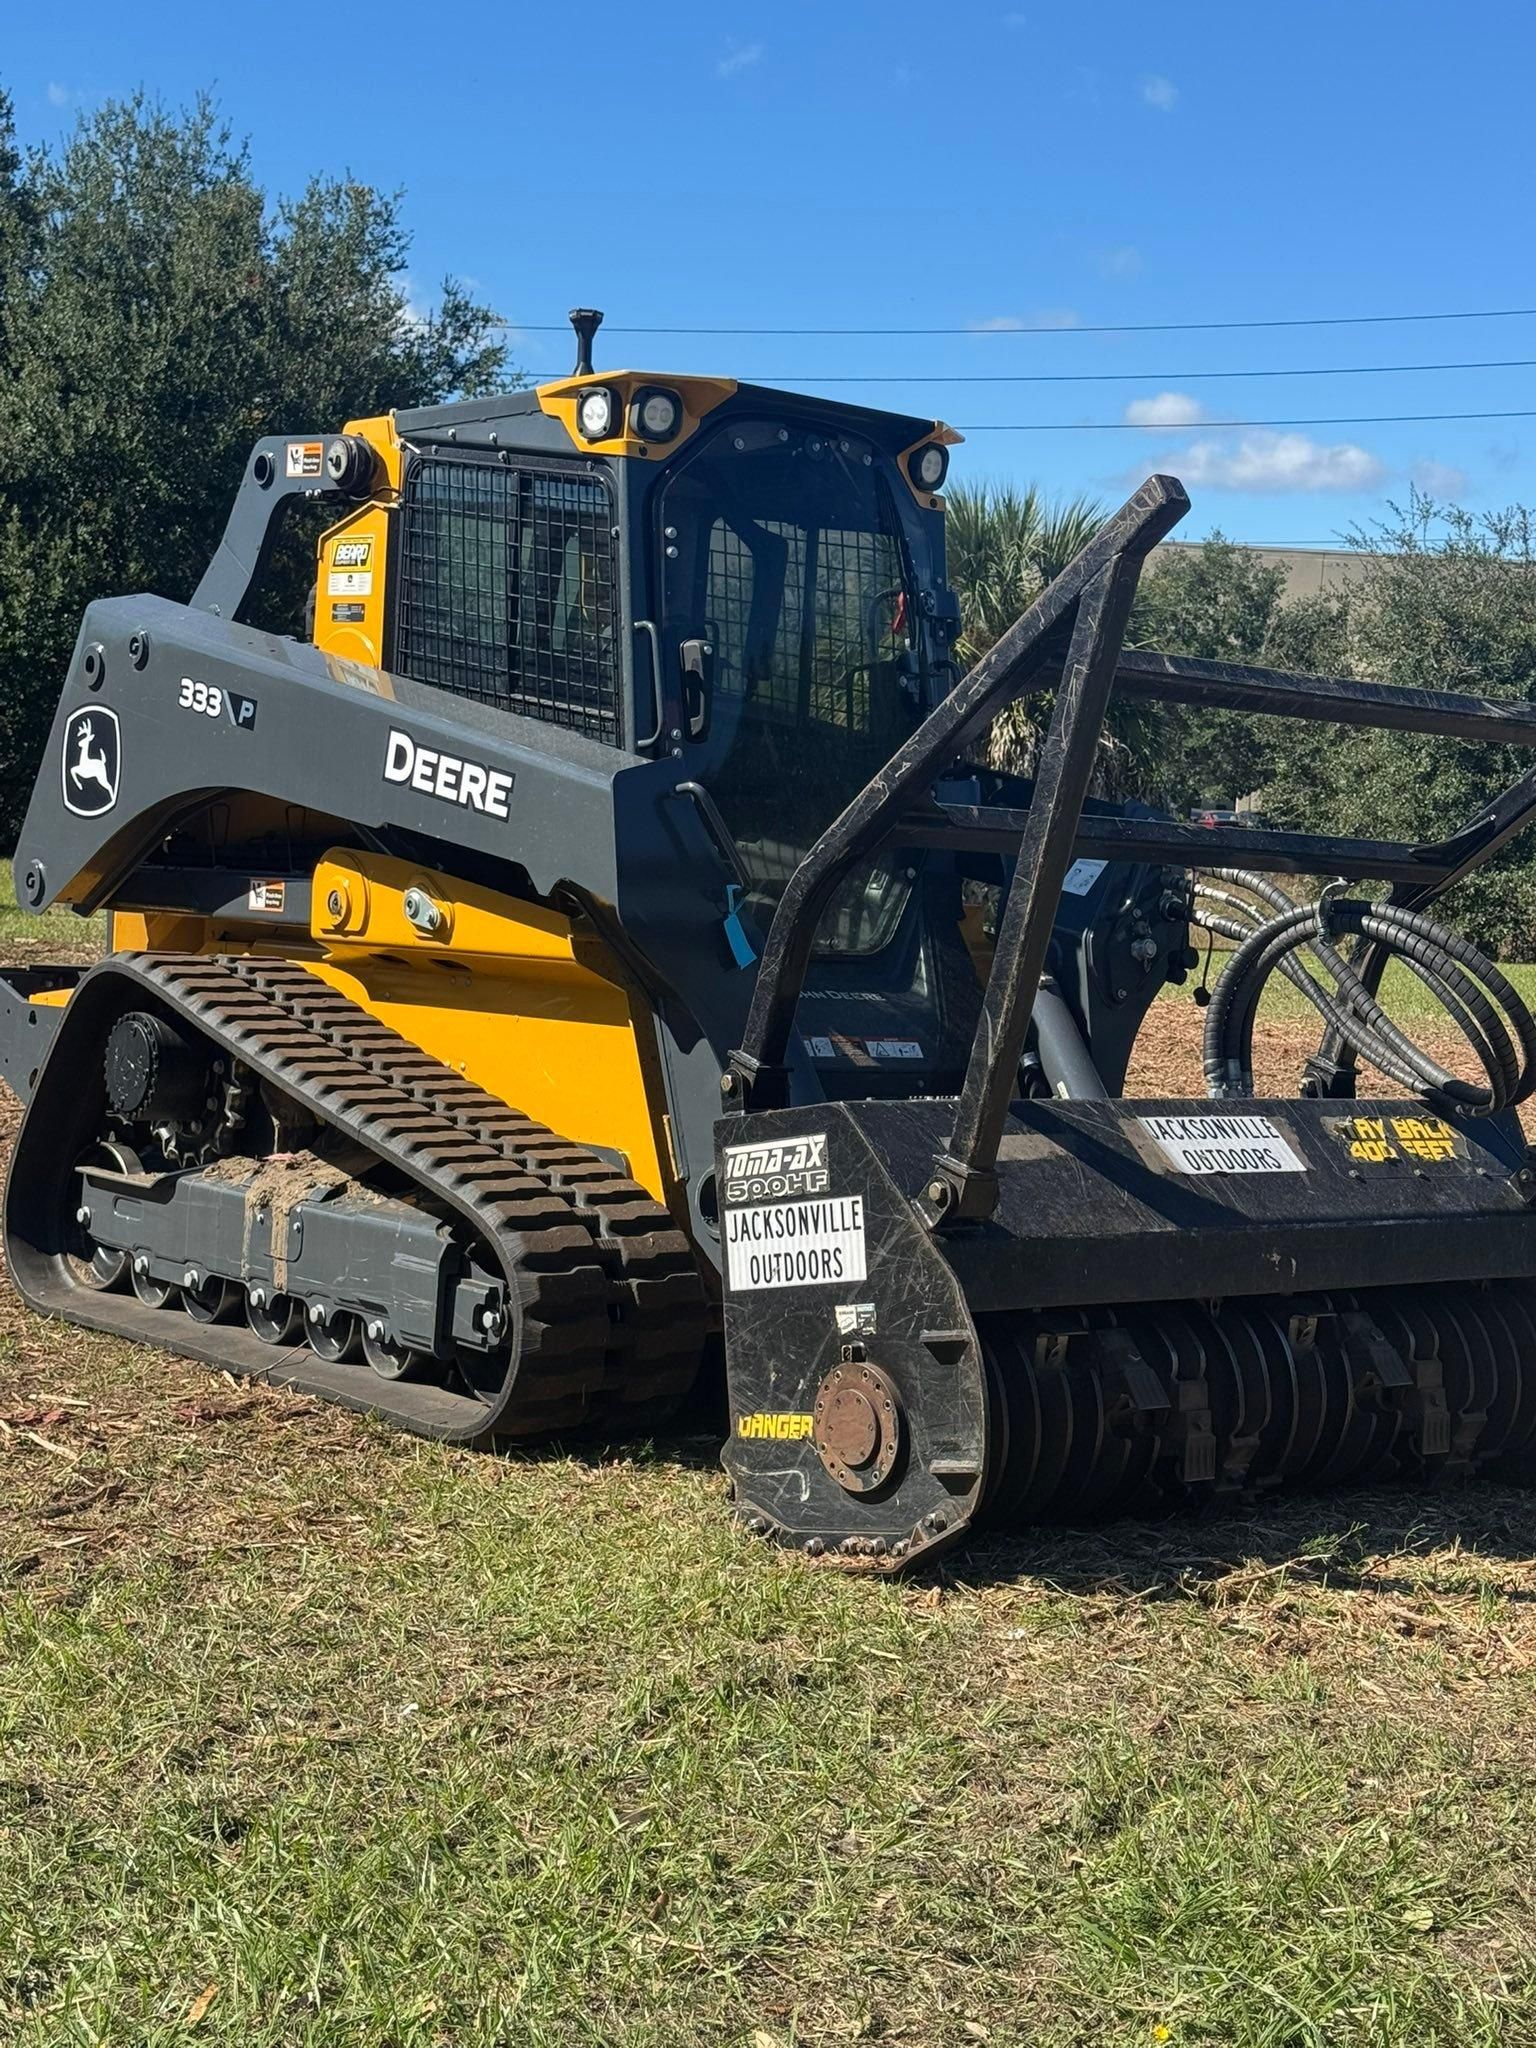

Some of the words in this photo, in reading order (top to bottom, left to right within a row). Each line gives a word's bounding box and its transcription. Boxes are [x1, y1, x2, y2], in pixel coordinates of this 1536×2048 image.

[179, 678, 222, 717] 333
[238, 700, 254, 723] P
[384, 730, 513, 818] DEERE
[825, 990, 886, 1001] DEERE
[1145, 1118, 1280, 1141] JACKSONVILLE
[1183, 1148, 1282, 1171] OUTDOORS
[729, 1200, 862, 1243] JACKSONVILLE
[750, 1247, 843, 1285] OUTDOORS
[738, 1413, 814, 1439] DANGER
